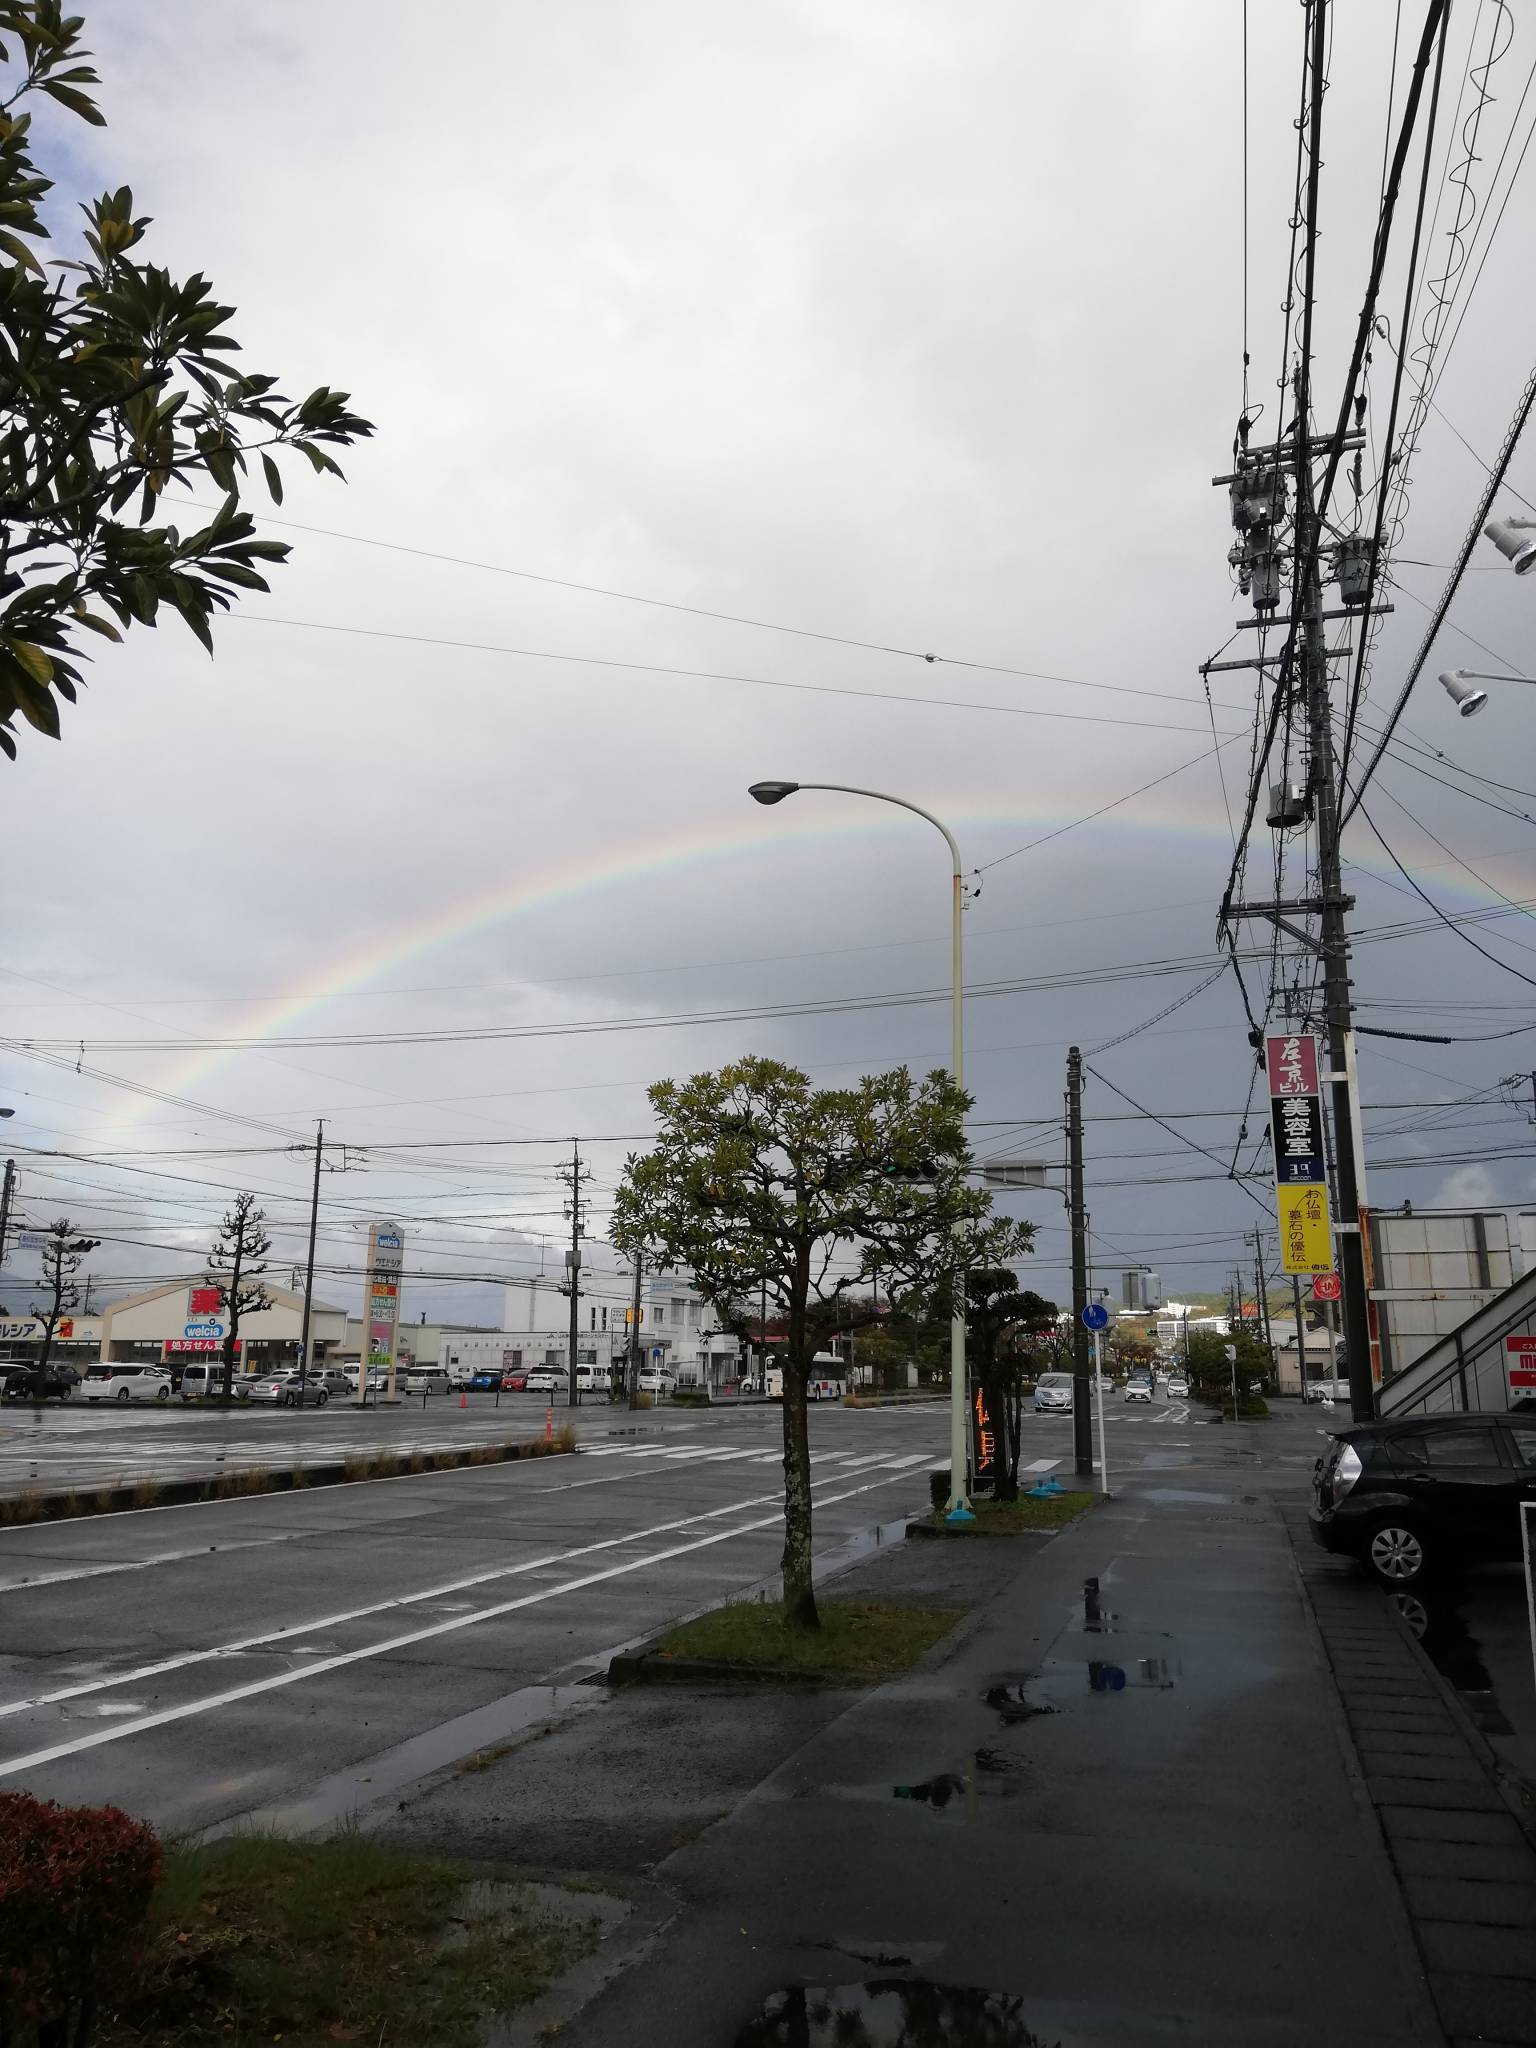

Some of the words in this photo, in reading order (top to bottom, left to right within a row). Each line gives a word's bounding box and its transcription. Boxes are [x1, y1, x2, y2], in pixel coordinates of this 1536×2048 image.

[1279, 1082, 1309, 1093] ビル
[1281, 1098, 1315, 1156] 美容室
[1288, 1209, 1306, 1262] 墓石の優伝
[190, 1288, 222, 1314] 薬
[186, 1322, 221, 1337] welcia
